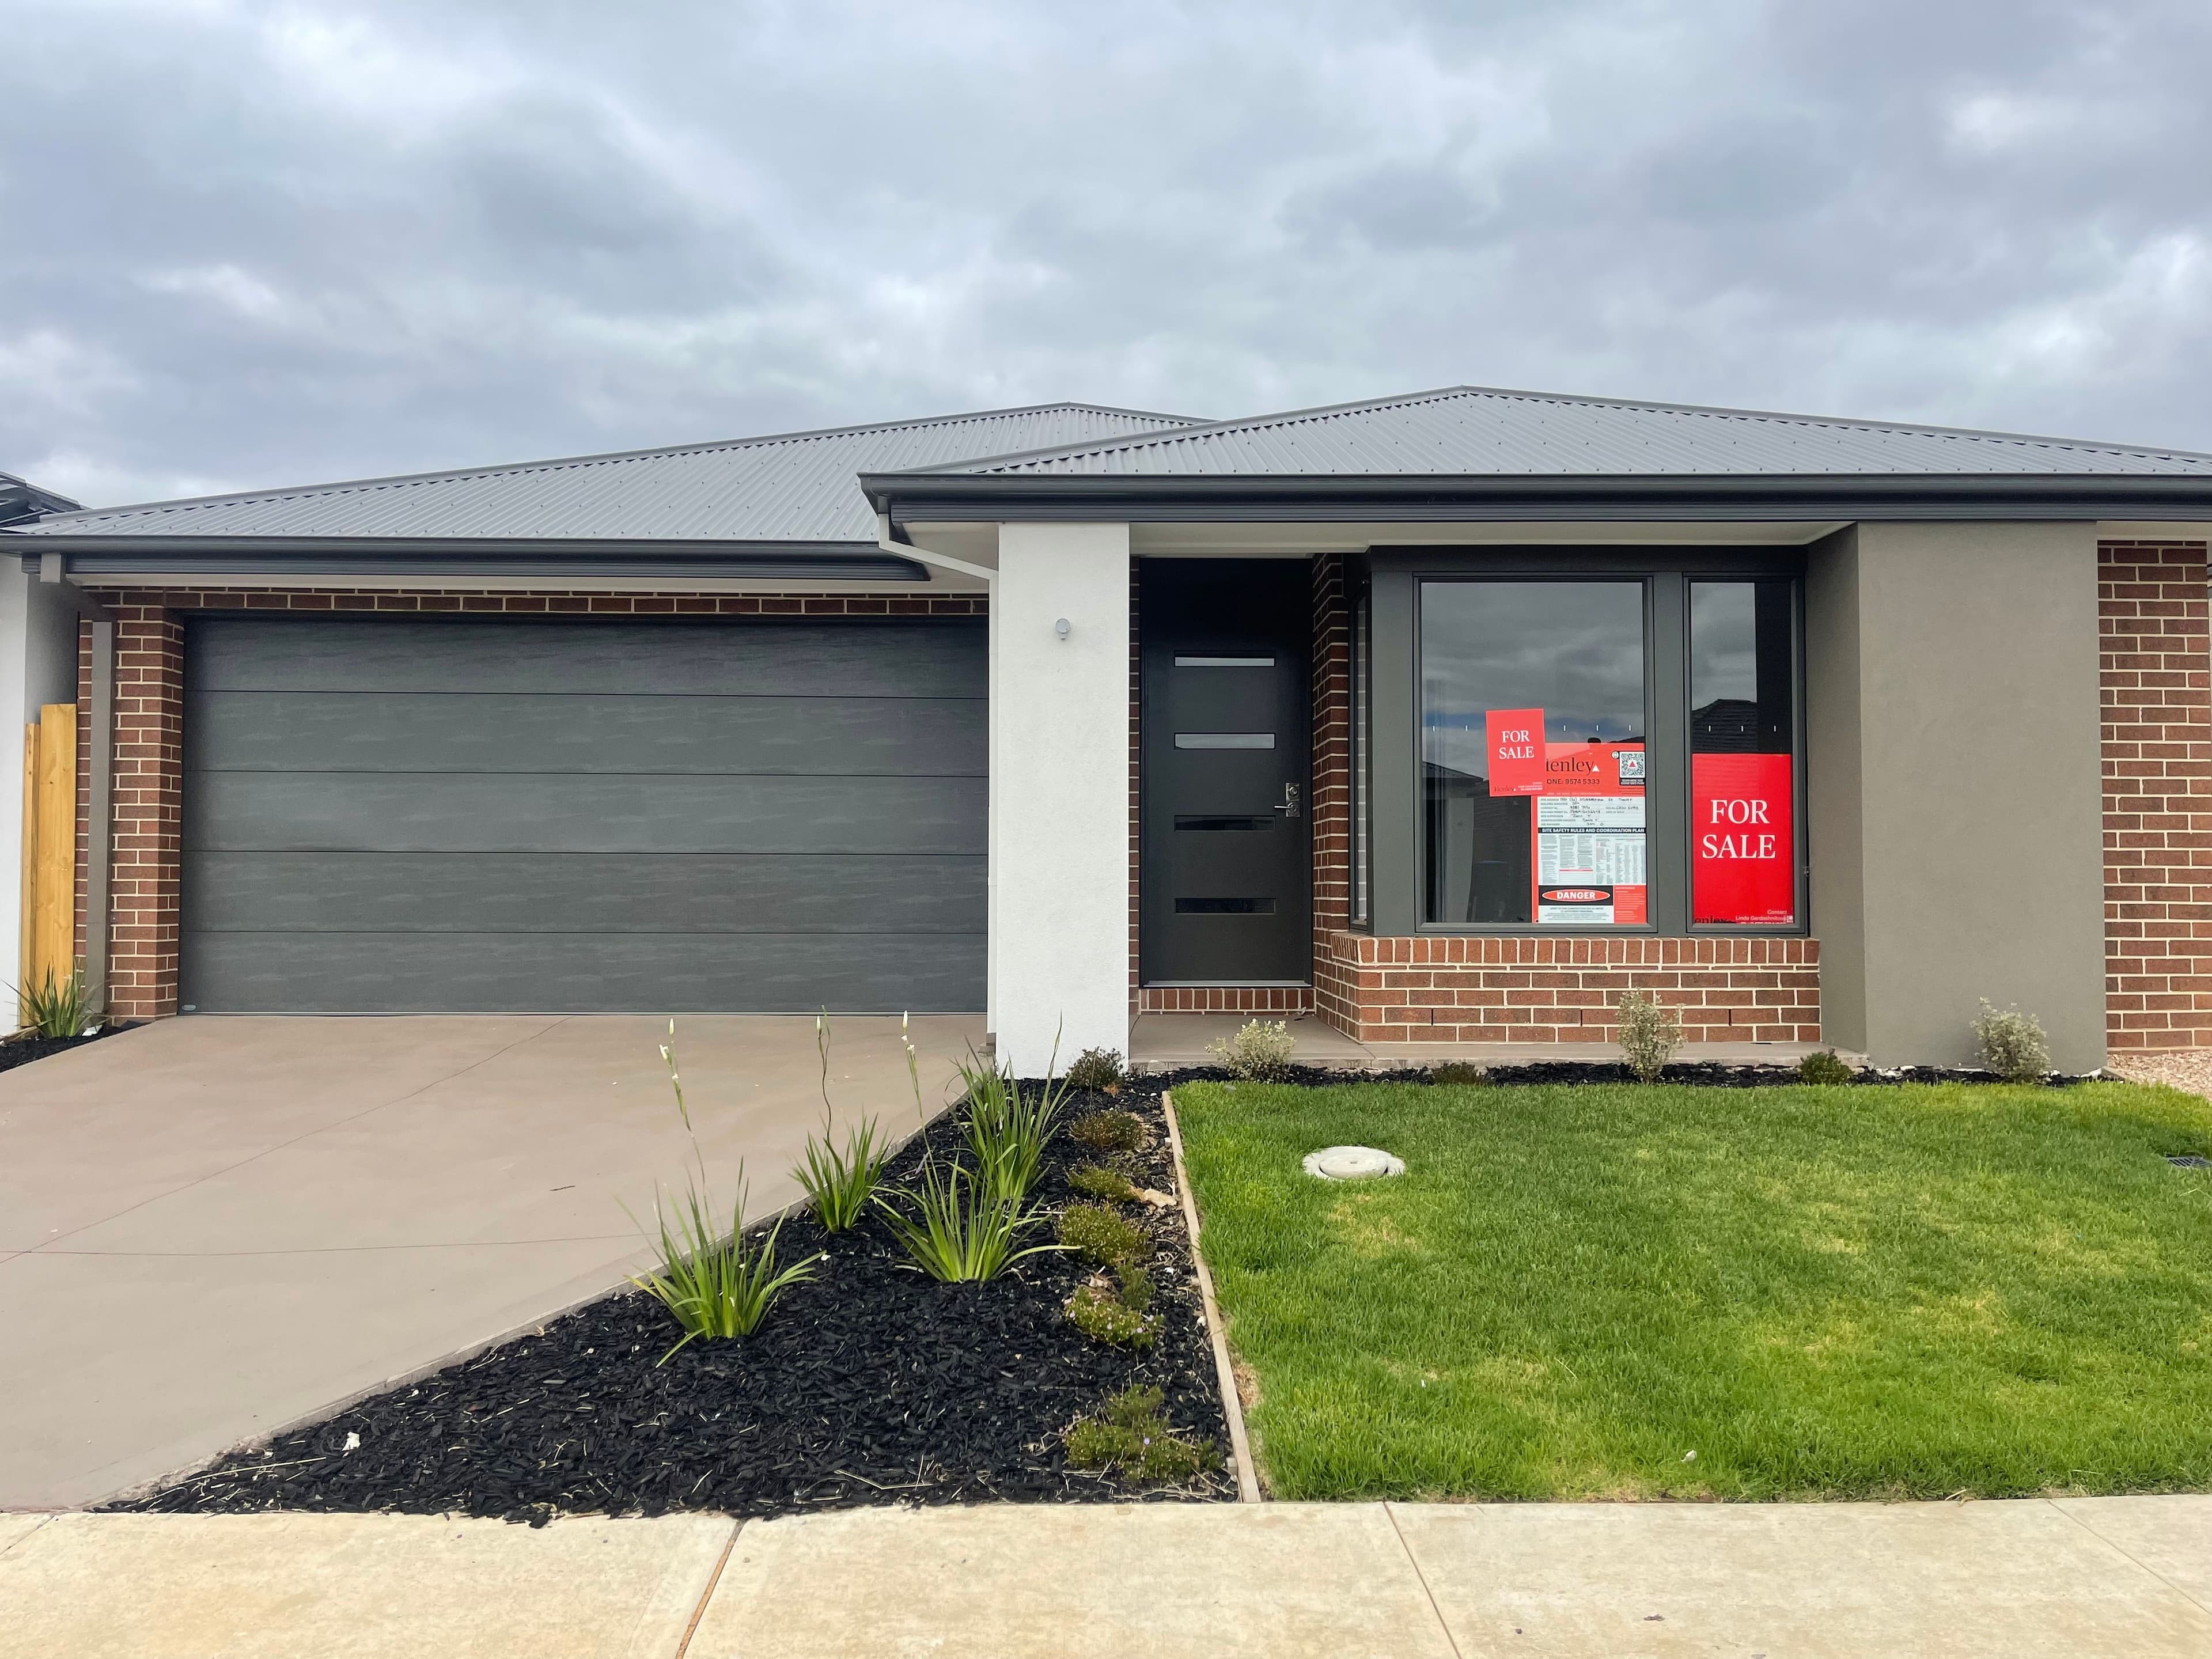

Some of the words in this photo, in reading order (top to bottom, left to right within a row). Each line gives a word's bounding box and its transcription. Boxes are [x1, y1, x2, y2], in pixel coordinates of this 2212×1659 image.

[1502, 730, 1530, 743] FOR
[1499, 746, 1535, 759] SALE
[1710, 799, 1770, 824] FOR
[1702, 834, 1776, 858] SALE
